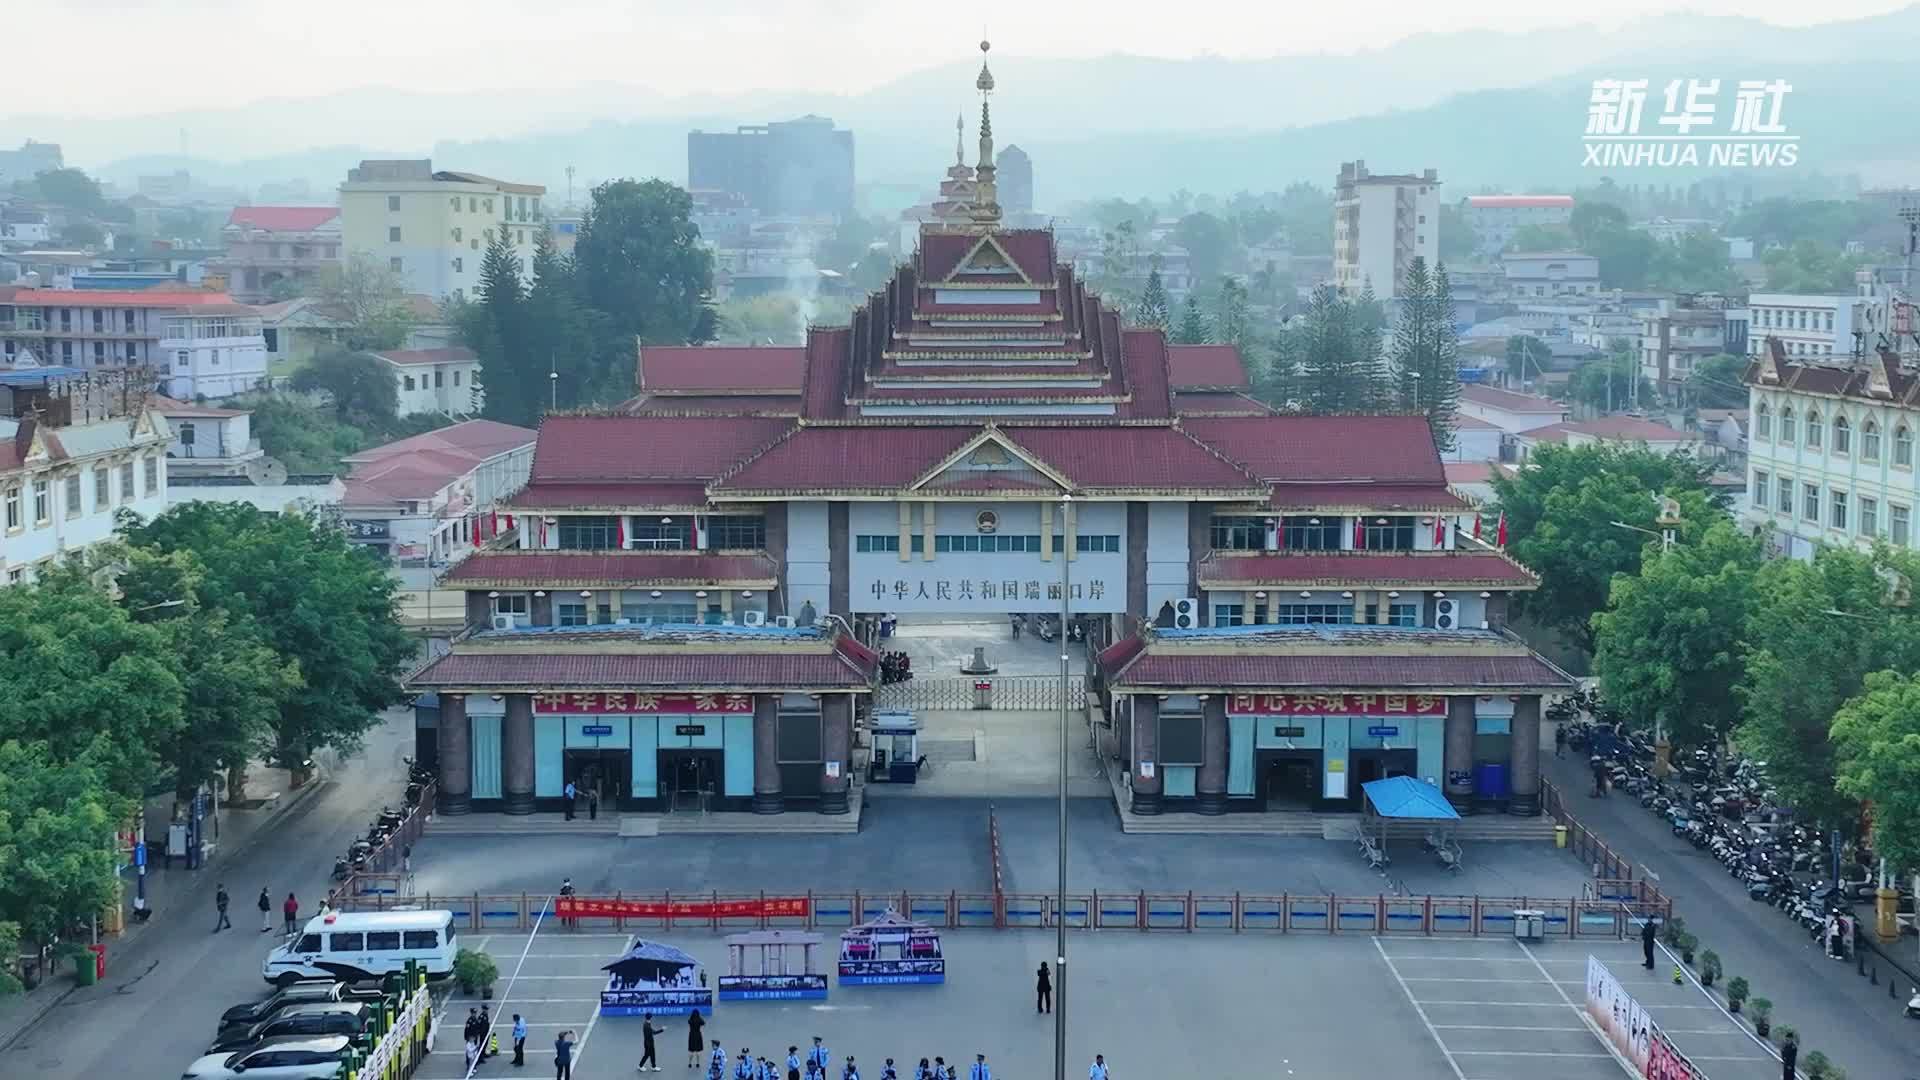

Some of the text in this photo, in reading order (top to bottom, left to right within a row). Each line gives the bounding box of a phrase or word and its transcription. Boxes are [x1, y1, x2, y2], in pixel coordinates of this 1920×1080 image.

[871, 579, 1105, 601] 中华人民共和国瑞丽口岸
